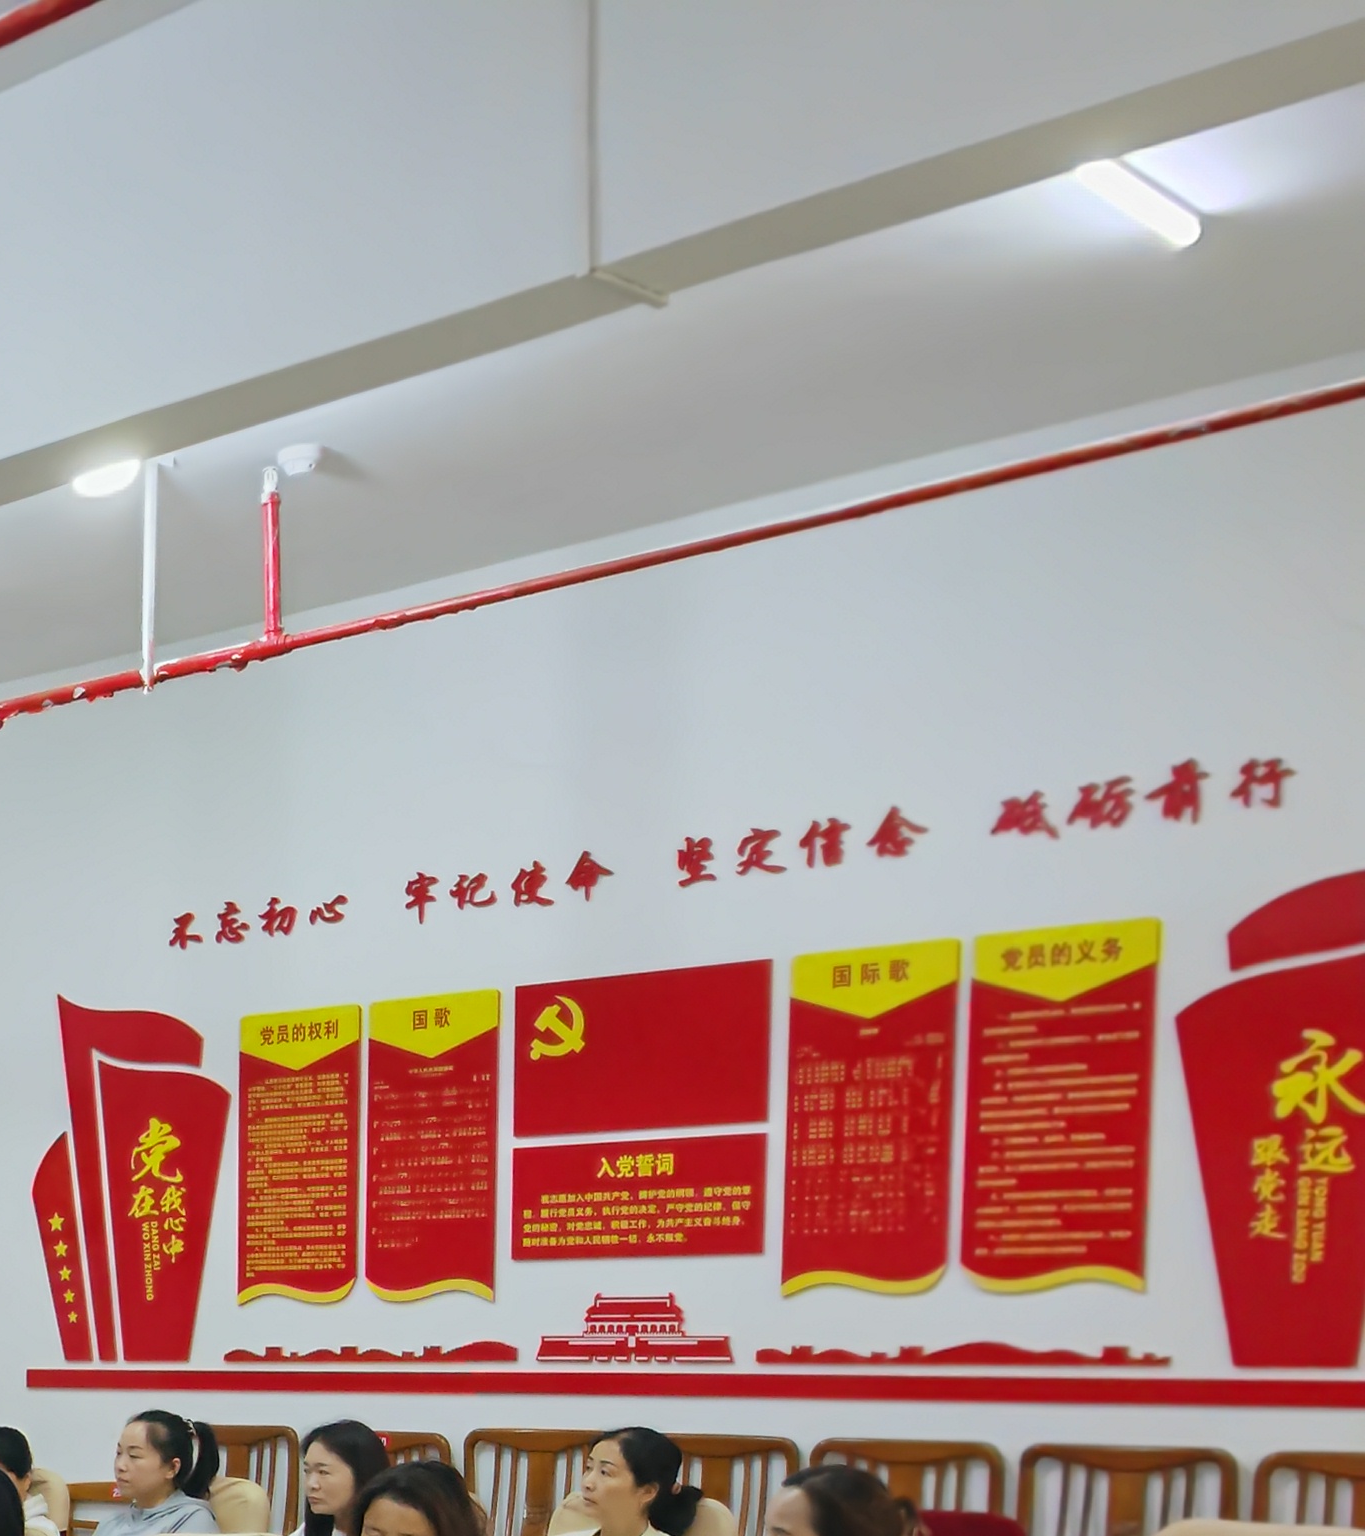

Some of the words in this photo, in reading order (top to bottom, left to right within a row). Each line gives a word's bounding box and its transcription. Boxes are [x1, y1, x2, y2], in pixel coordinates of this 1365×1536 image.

[169, 895, 349, 950] 不忘初心
[405, 850, 615, 924] 牢记使命
[677, 806, 928, 887] 坚定信念
[991, 759, 1295, 840] 砥砺前行
[1000, 937, 1123, 972] 党员的义务
[832, 959, 910, 988] 国际歌
[260, 1020, 339, 1046] 党员的权利
[412, 1008, 451, 1031] 国歌
[597, 1153, 674, 1178] 入党誓词
